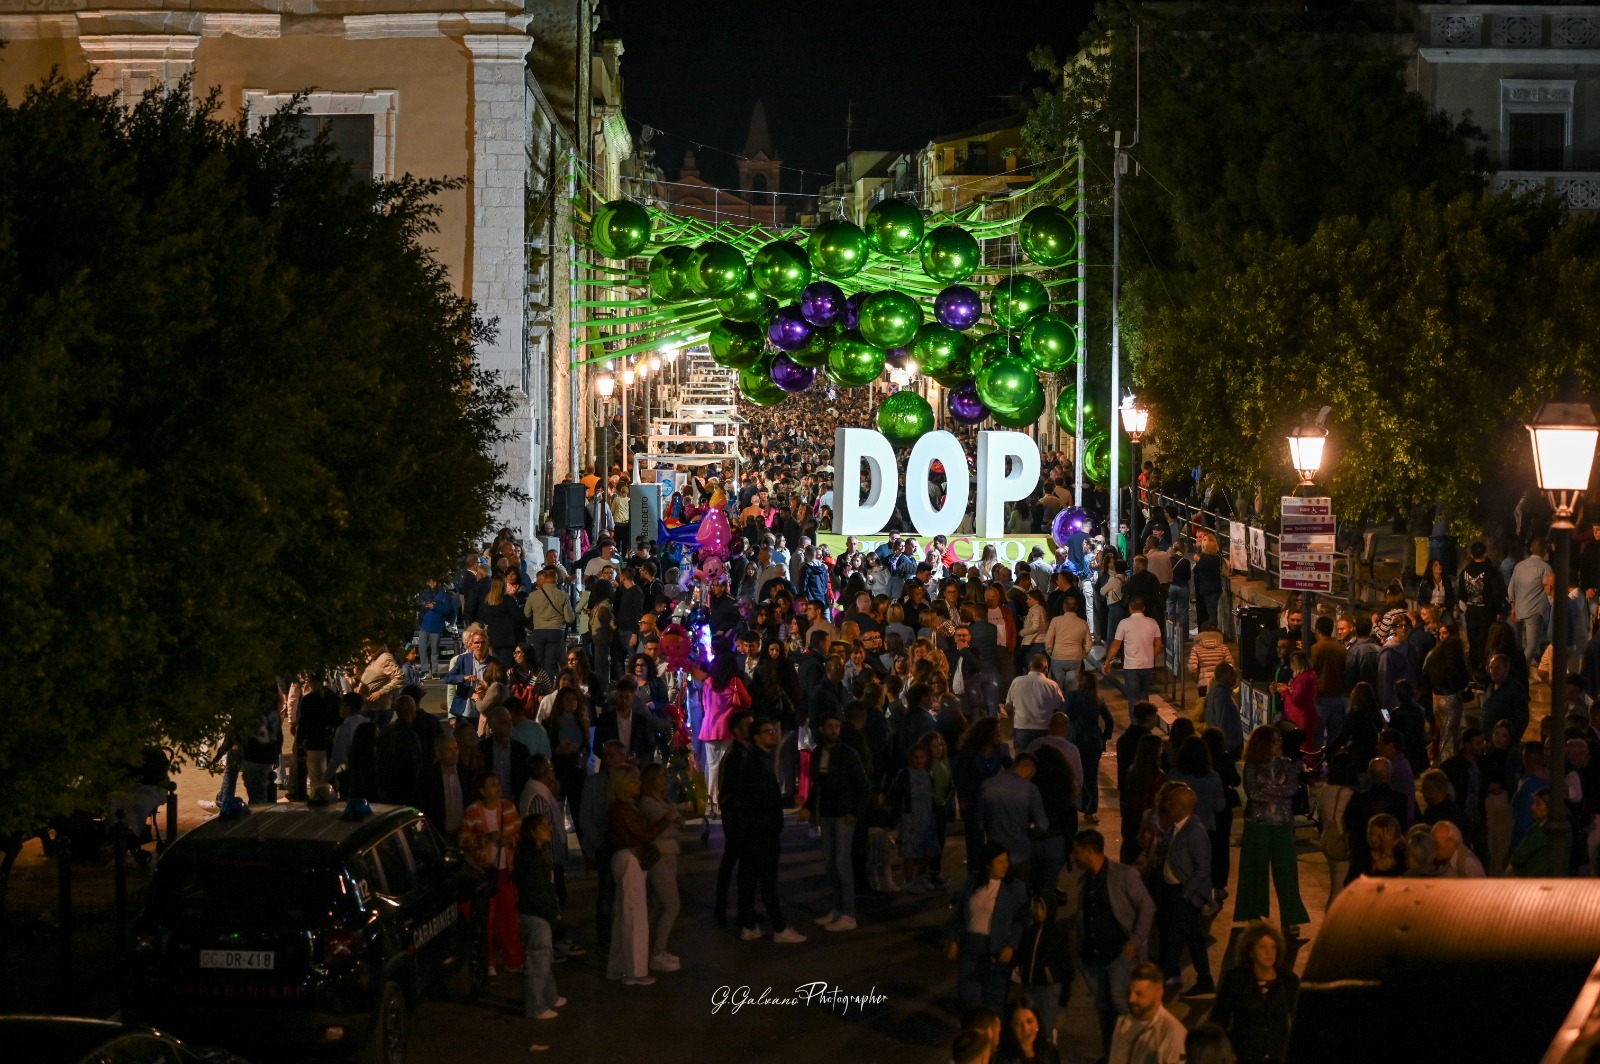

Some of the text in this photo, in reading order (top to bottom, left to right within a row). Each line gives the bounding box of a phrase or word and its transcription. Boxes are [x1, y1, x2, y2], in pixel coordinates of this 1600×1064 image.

[832, 427, 1041, 538] DOP
[413, 902, 459, 949] CARABINIERI
[226, 952, 242, 967] DR
[247, 953, 271, 968] 418
